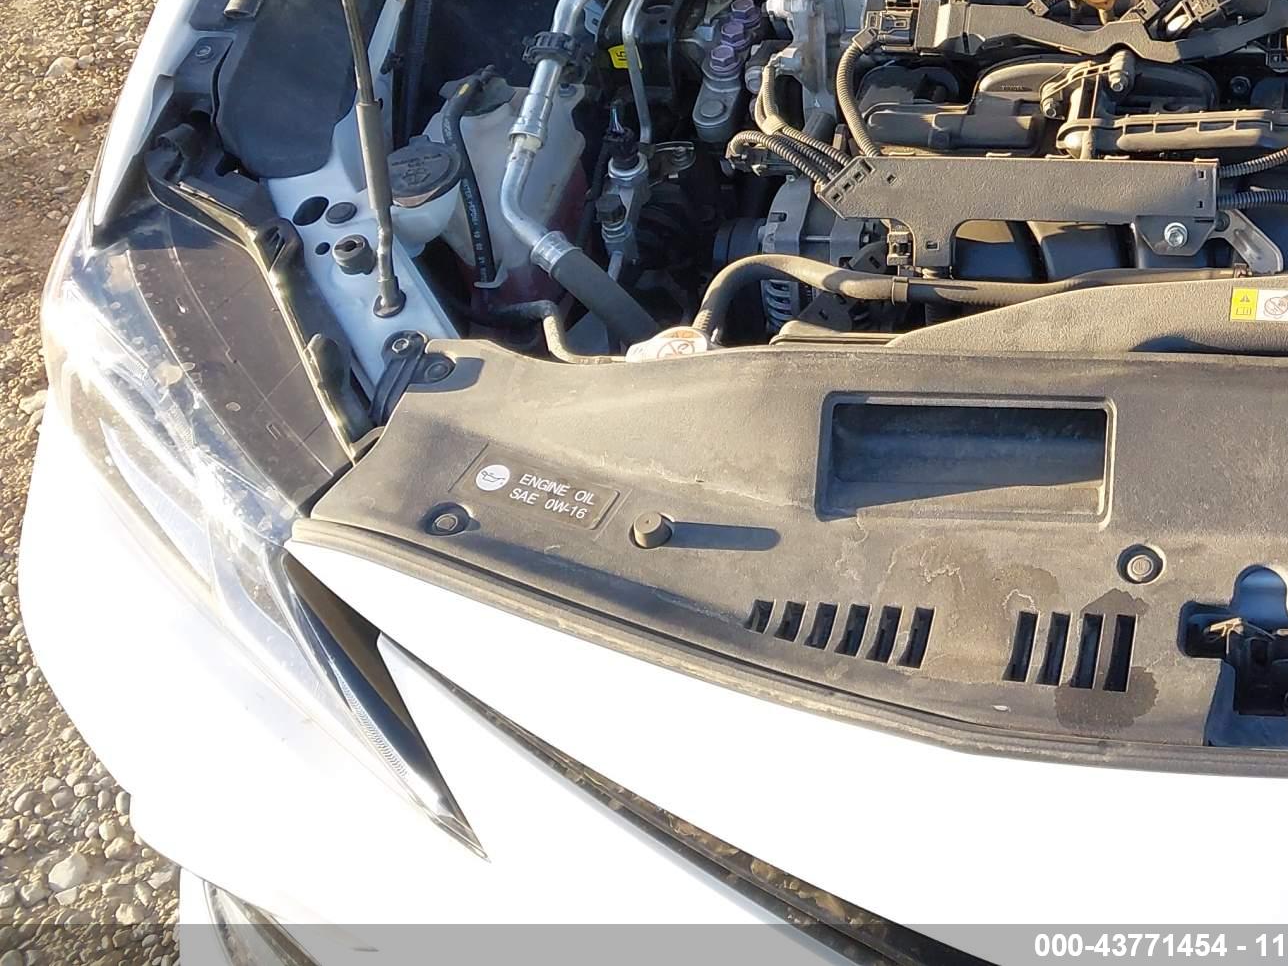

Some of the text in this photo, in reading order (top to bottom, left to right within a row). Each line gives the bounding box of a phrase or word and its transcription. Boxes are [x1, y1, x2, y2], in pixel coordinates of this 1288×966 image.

[509, 488, 588, 519] SAE 0W-16
[519, 473, 596, 506] ENGINE OIL
